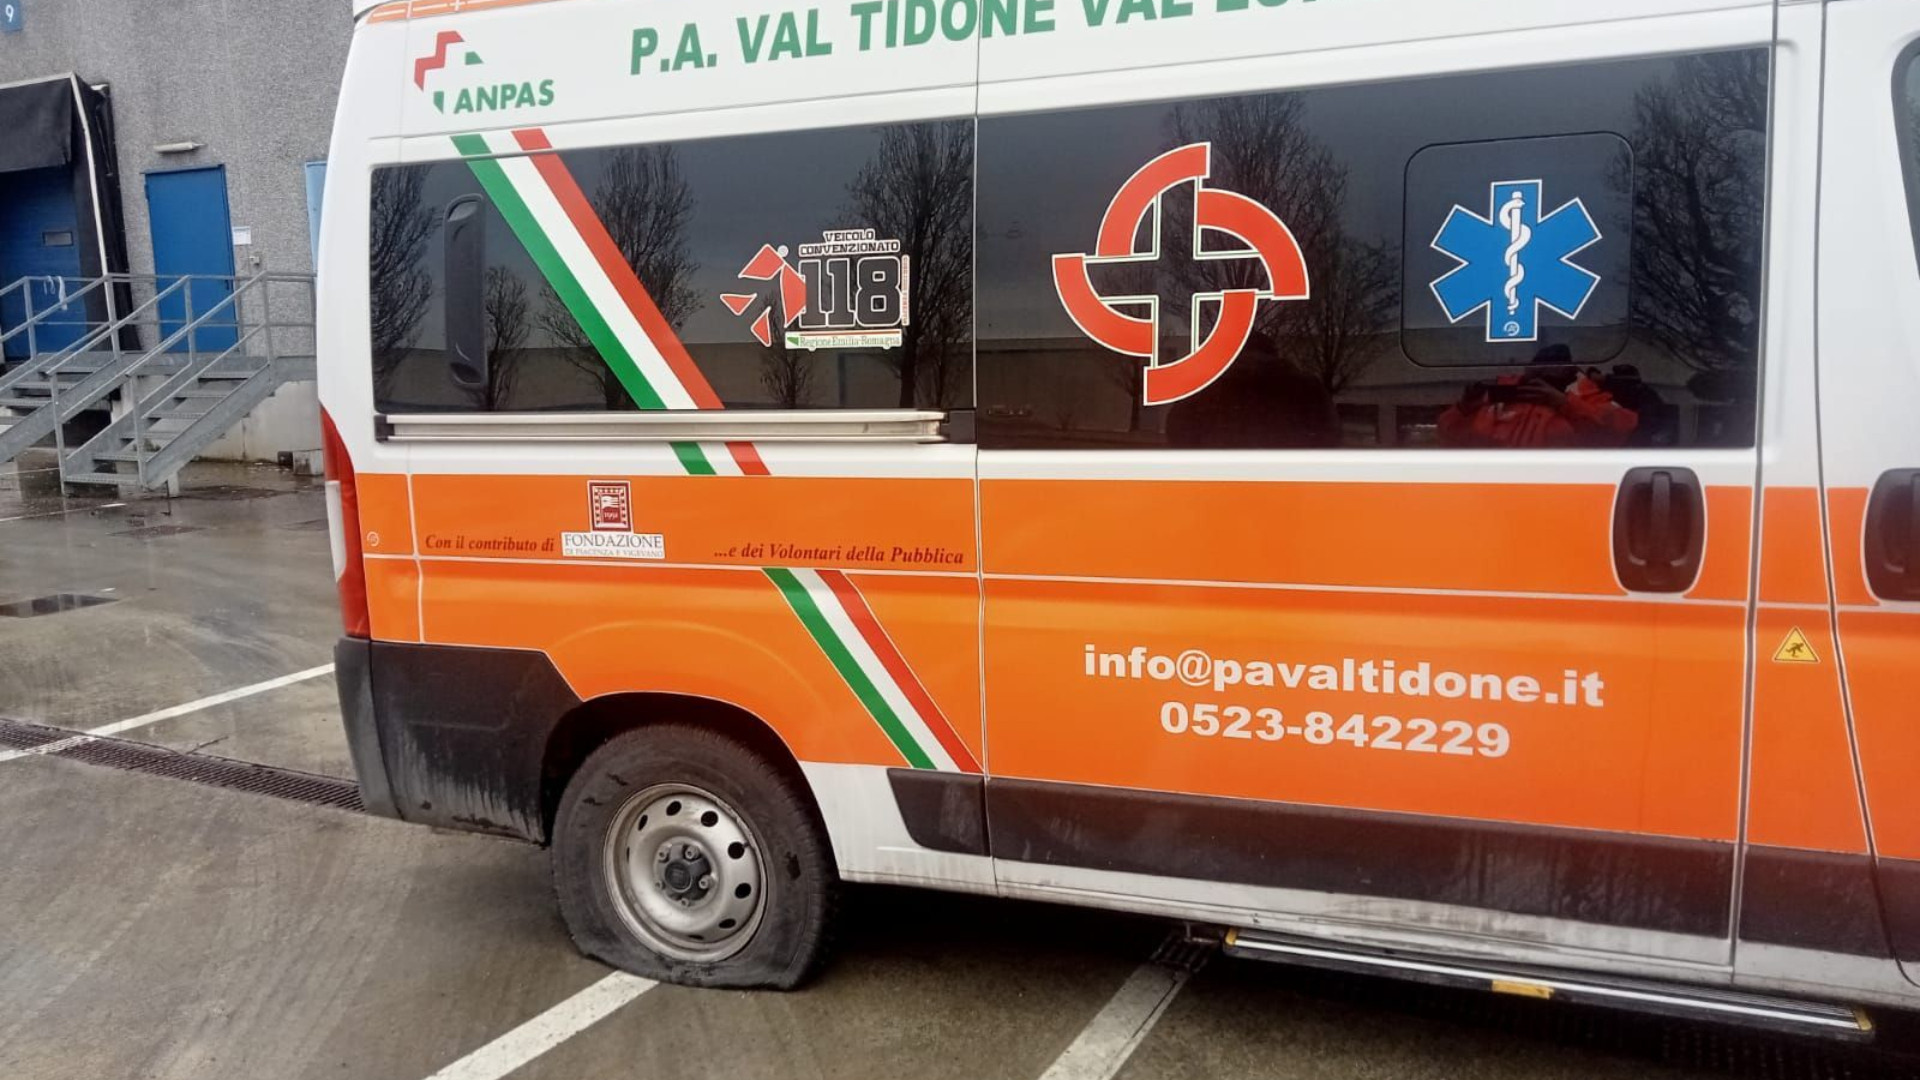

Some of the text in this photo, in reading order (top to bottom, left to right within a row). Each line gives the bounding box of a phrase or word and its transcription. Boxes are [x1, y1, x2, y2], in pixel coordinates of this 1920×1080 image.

[5, 4, 14, 23] 9
[630, 23, 717, 75] P.A.
[736, 9, 833, 64] VAL
[850, 0, 1056, 52] TIDONE
[453, 79, 555, 114] ANPAS
[825, 230, 875, 242] VEICOLO
[800, 241, 900, 255] CONVENZIONATO
[798, 256, 901, 328] 118
[425, 534, 554, 552] Con il contributo di
[564, 534, 663, 549] FONDAZIONE
[741, 543, 764, 559] dei
[769, 544, 841, 562] Volontari
[846, 546, 884, 562] della
[890, 546, 964, 565] Pubblica
[1084, 644, 1604, 707] info@pavaltidone.it
[1160, 701, 1511, 758] 0523-842229
